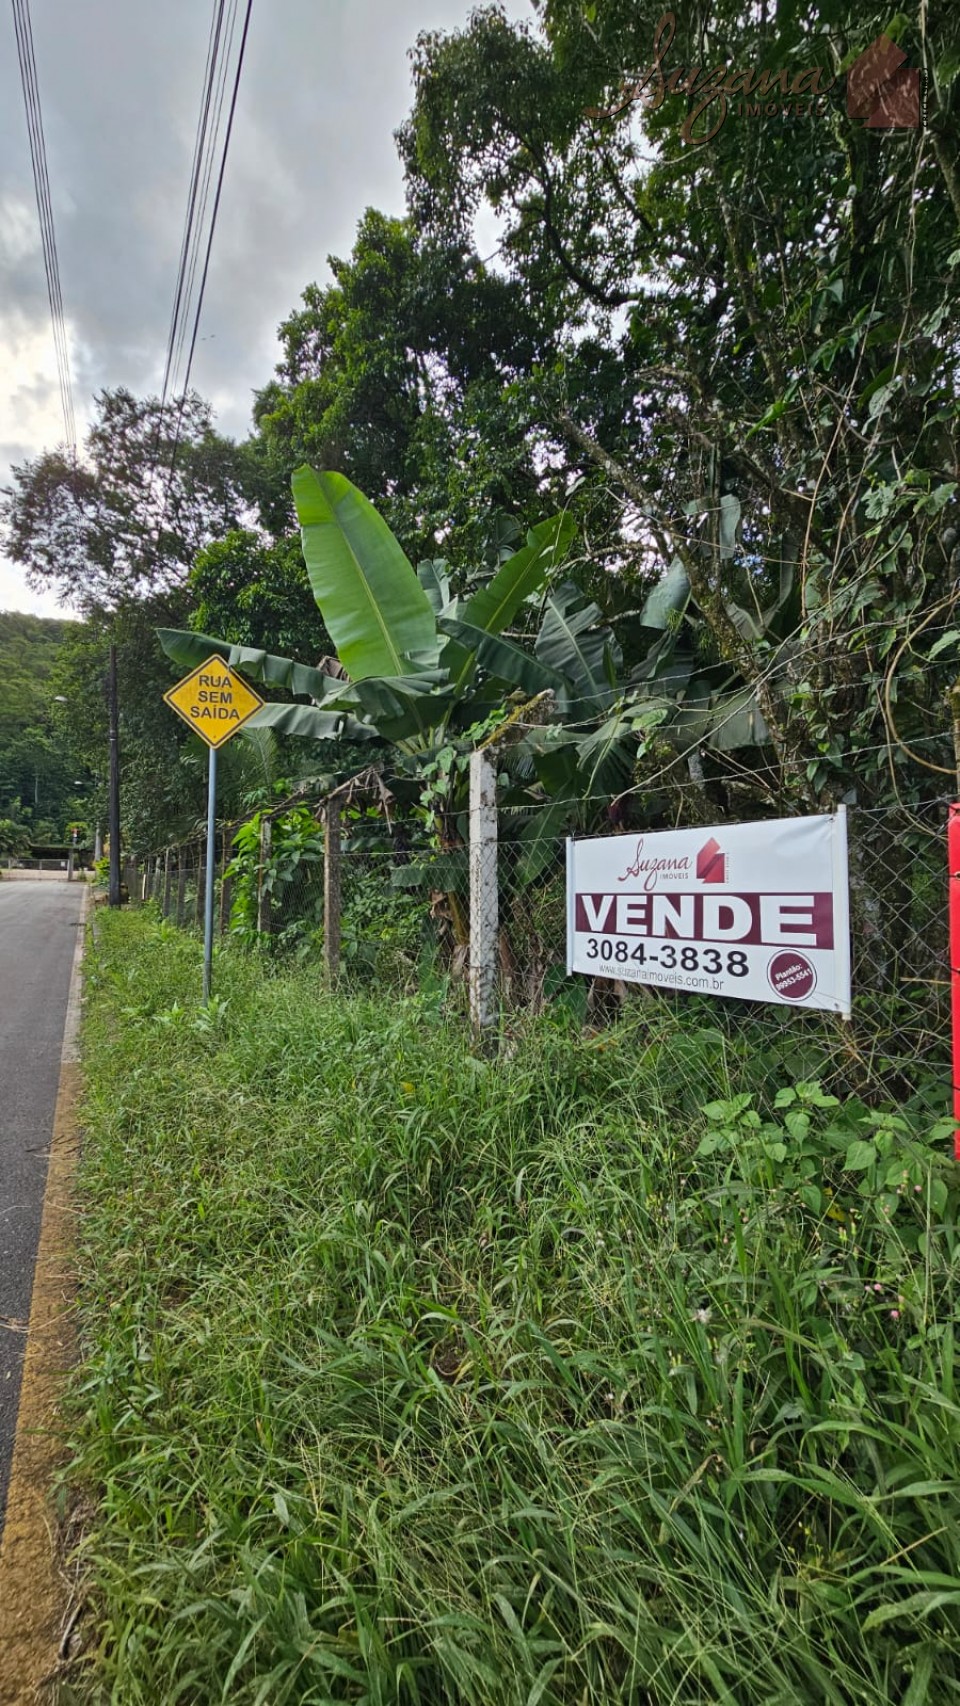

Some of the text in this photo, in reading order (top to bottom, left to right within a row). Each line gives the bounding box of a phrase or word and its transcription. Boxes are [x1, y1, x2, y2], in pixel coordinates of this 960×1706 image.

[198, 675, 232, 688] RUA
[198, 691, 232, 704] SEM
[190, 705, 240, 720] SAÍDA
[617, 838, 693, 892] Suzana
[581, 894, 817, 946] VENDE
[586, 938, 750, 978] 3084-3838
[598, 964, 724, 991] www.suzanaimoveis.com.br
